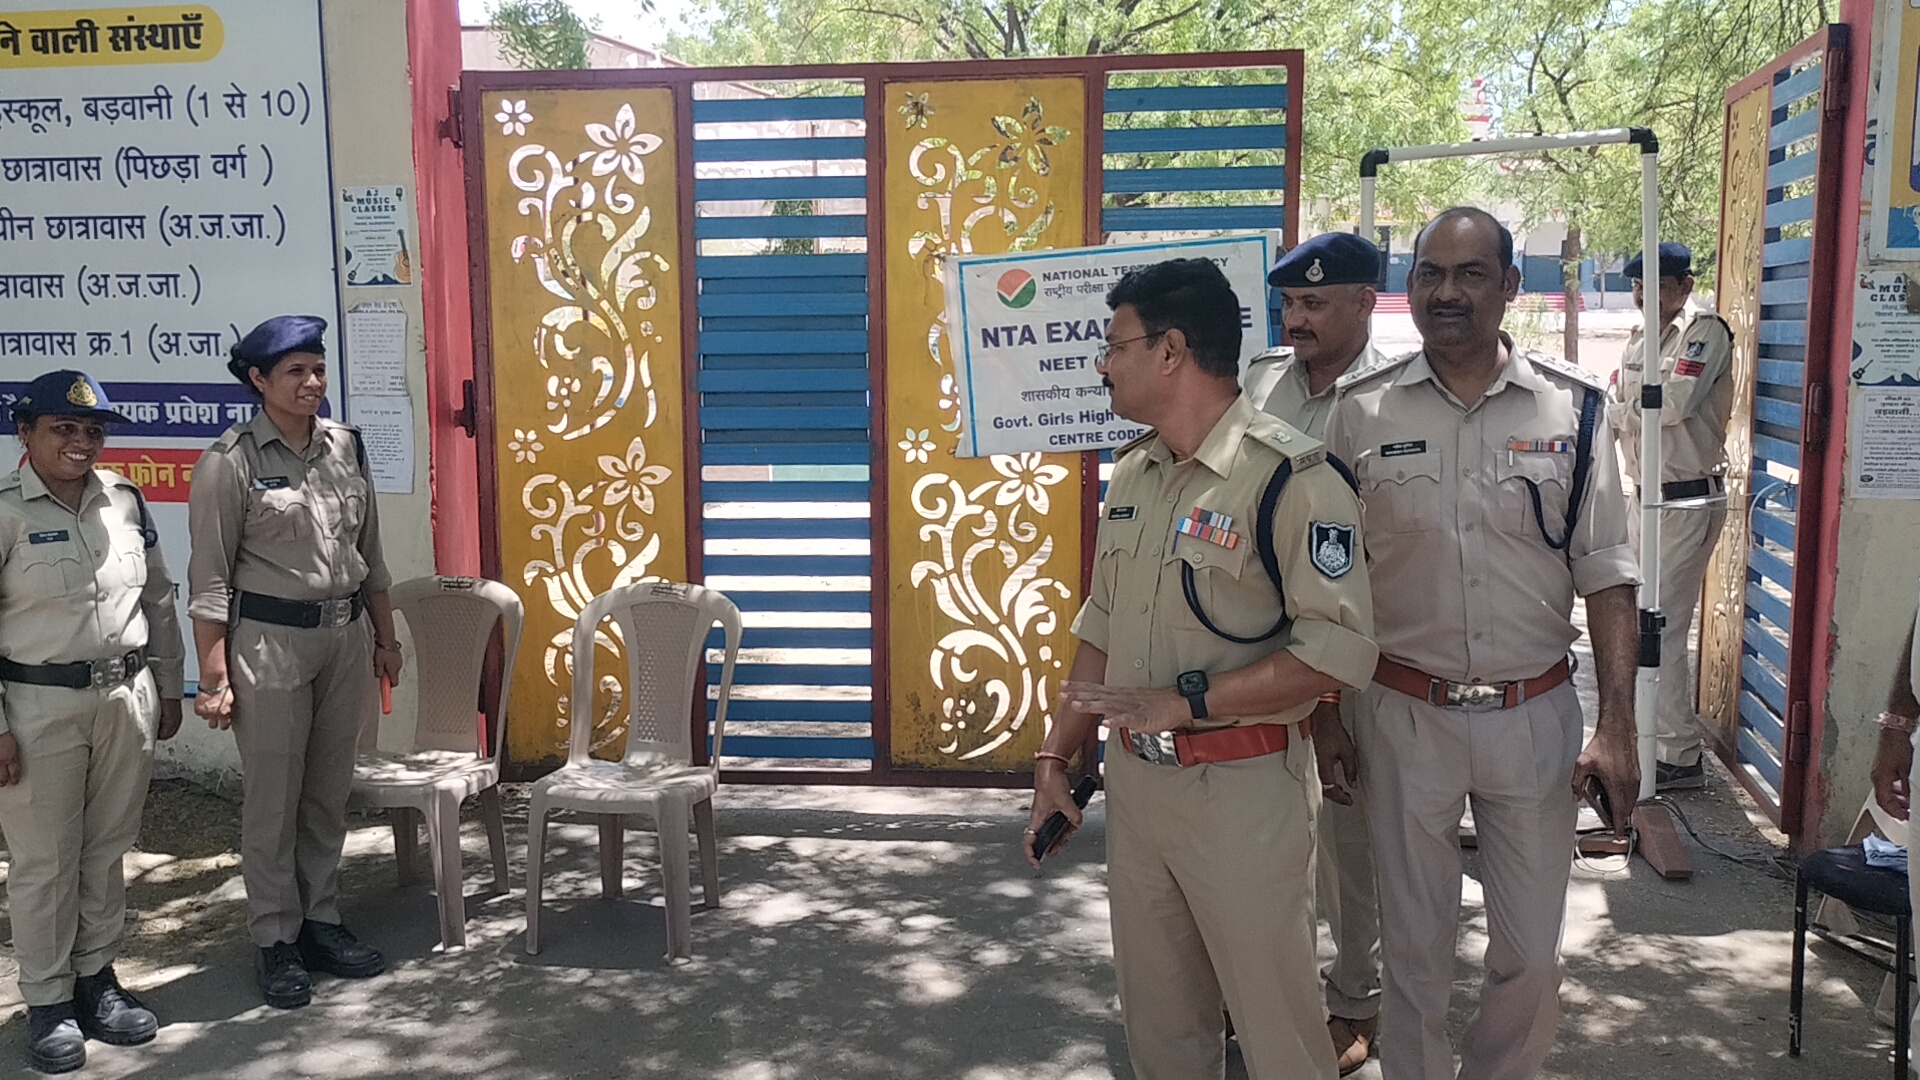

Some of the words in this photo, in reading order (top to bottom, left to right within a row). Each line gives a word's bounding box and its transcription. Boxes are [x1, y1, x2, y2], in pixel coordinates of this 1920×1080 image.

[28, 18, 100, 54] वाली
[106, 13, 203, 52] संस्थाएँ
[0, 91, 72, 134] स्कूल,
[82, 84, 173, 126] बड़वानी
[186, 84, 209, 127] (1
[223, 82, 247, 119] से
[260, 81, 310, 126] 10)
[1, 156, 102, 183] छात्रावास
[115, 146, 200, 189] (पिछड़ा
[210, 144, 248, 179] वर्ग
[351, 204, 397, 213] CLASSES
[356, 196, 390, 205] MUSIC
[44, 215, 146, 240] छात्रावास
[159, 204, 286, 247] (अ.ज.जा.)
[1042, 265, 1108, 282] NATIONAL
[77, 264, 201, 306] (अ.ज.जा.)
[1044, 281, 1073, 299] राष्ट्रीय
[1076, 279, 1104, 295] परीक्षा
[981, 324, 1038, 348] NTA
[1039, 356, 1088, 372] NEET
[1021, 384, 1071, 402] शासकीय
[164, 395, 219, 425] प्रवेश
[993, 415, 1033, 430] Govt.
[1038, 412, 1074, 427] Girls
[1079, 408, 1114, 426] High
[1049, 431, 1104, 446] CENTRE
